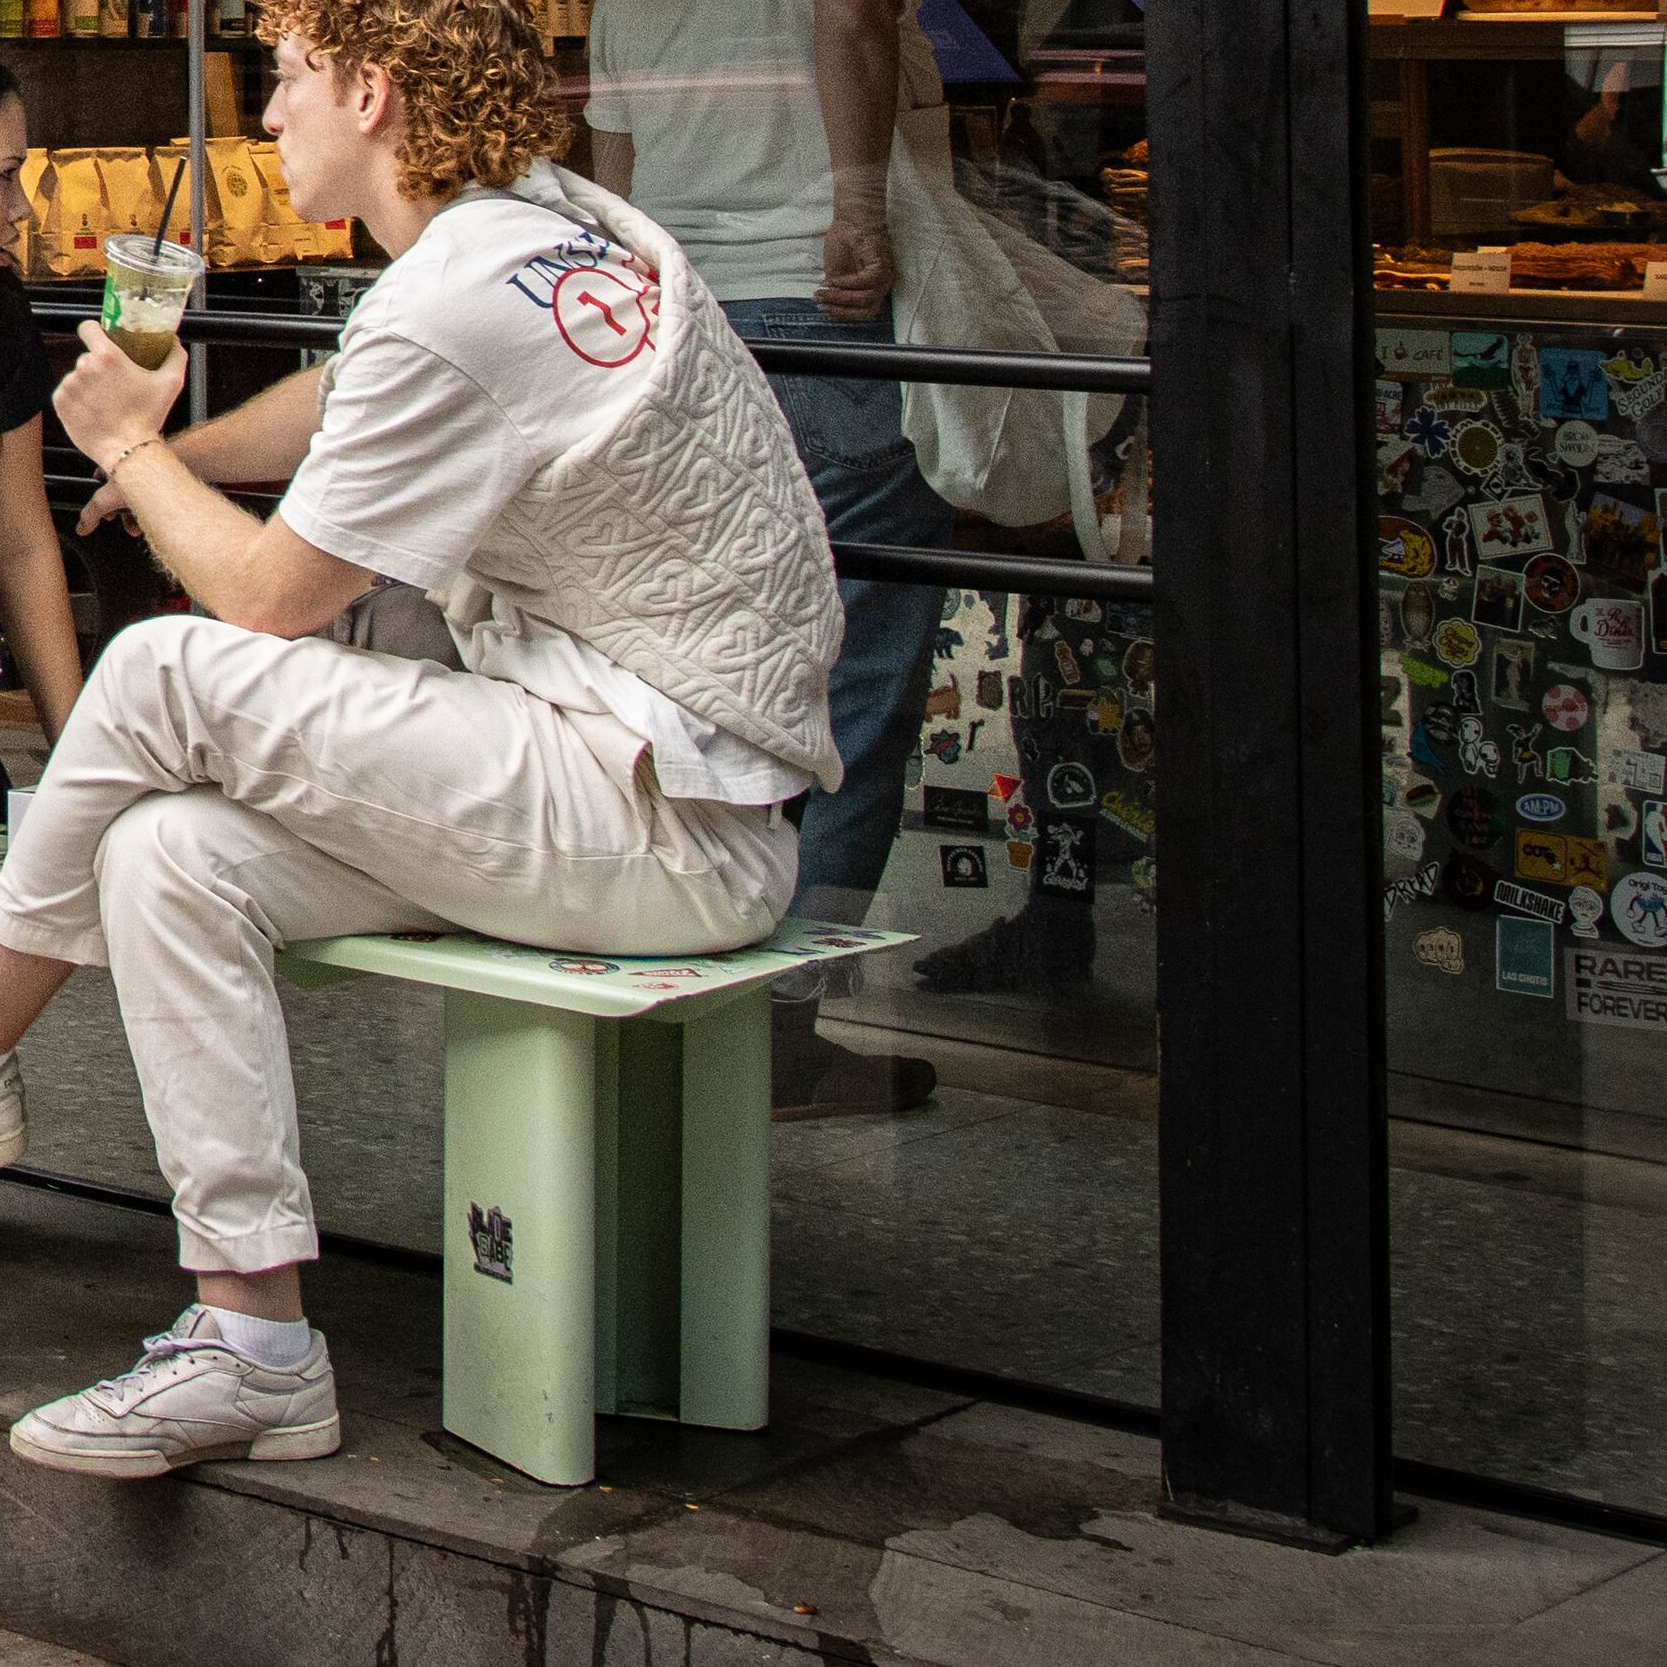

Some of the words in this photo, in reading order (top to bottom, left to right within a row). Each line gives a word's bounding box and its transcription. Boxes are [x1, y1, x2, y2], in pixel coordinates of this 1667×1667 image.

[1617, 371, 1667, 414] SEGUND
[1496, 883, 1565, 922] MILKSHAKE
[1574, 954, 1667, 982] RARE
